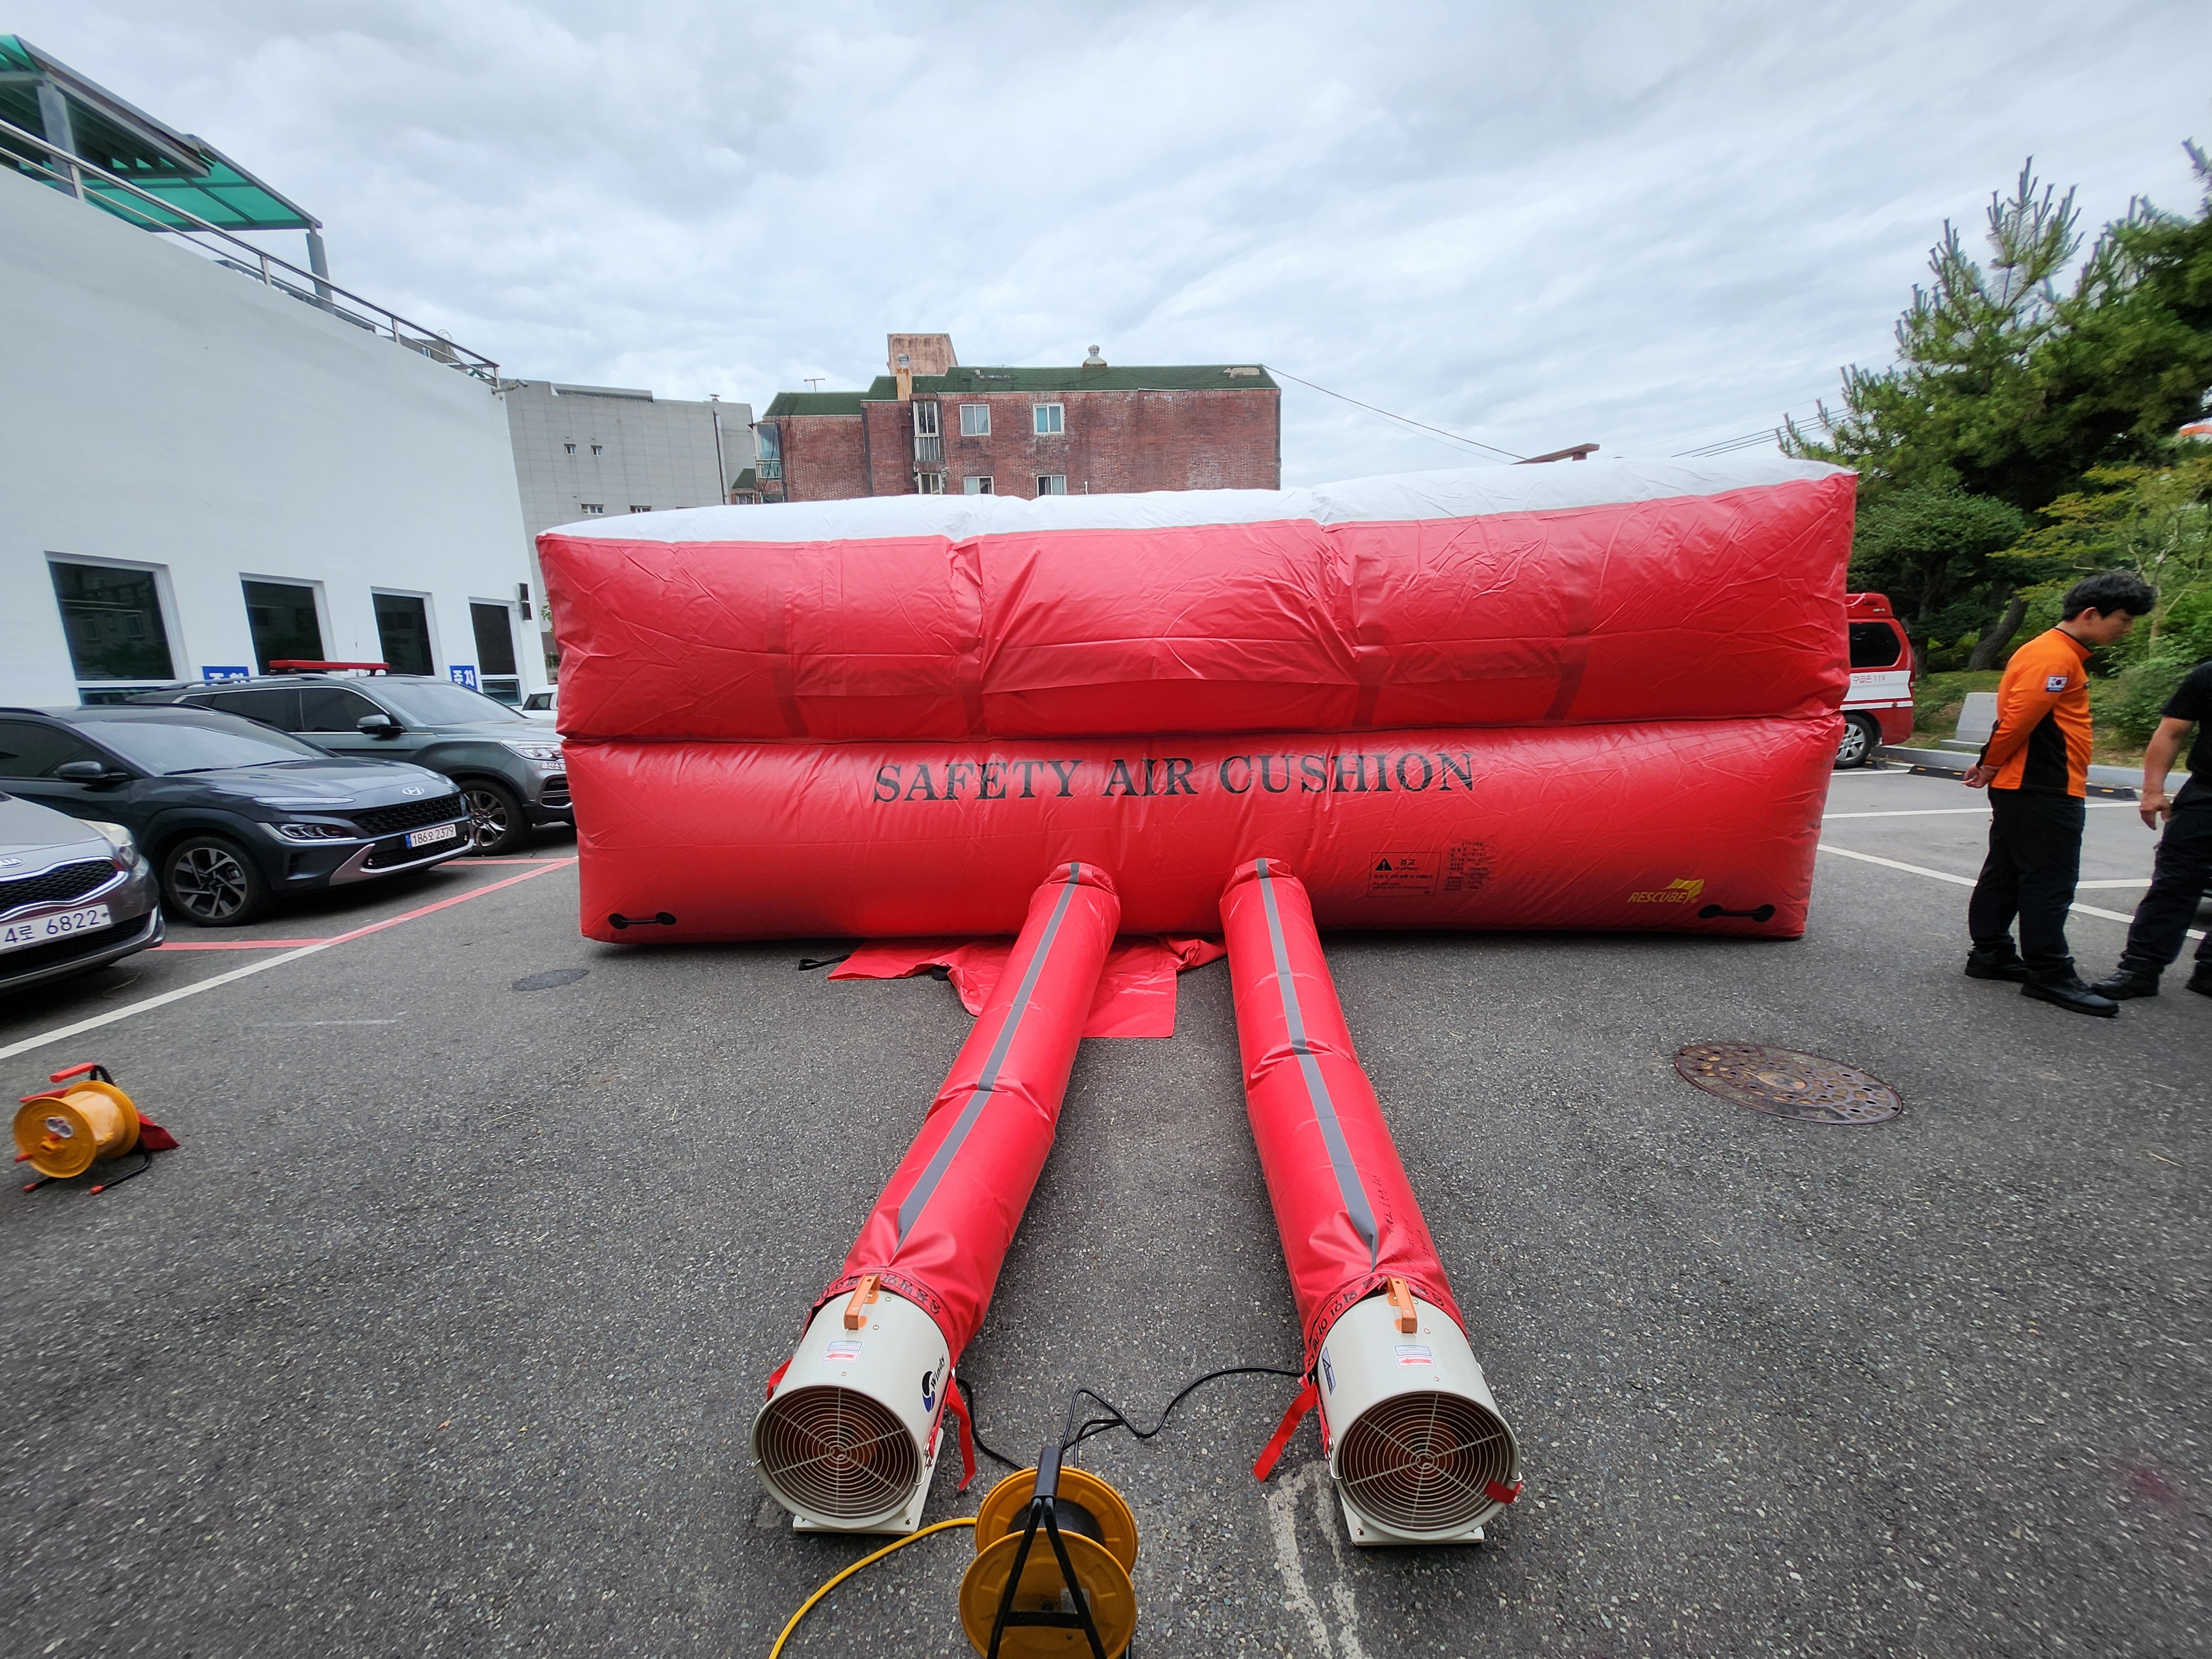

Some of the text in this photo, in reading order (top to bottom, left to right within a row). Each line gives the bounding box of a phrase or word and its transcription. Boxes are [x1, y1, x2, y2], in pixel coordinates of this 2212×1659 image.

[453, 670, 474, 686] 주차
[873, 753, 1474, 804] SAFETY AIR CUSHION
[435, 826, 453, 839] 2379
[5, 910, 100, 942] 4로 6822
[931, 1354, 945, 1390] Windy
